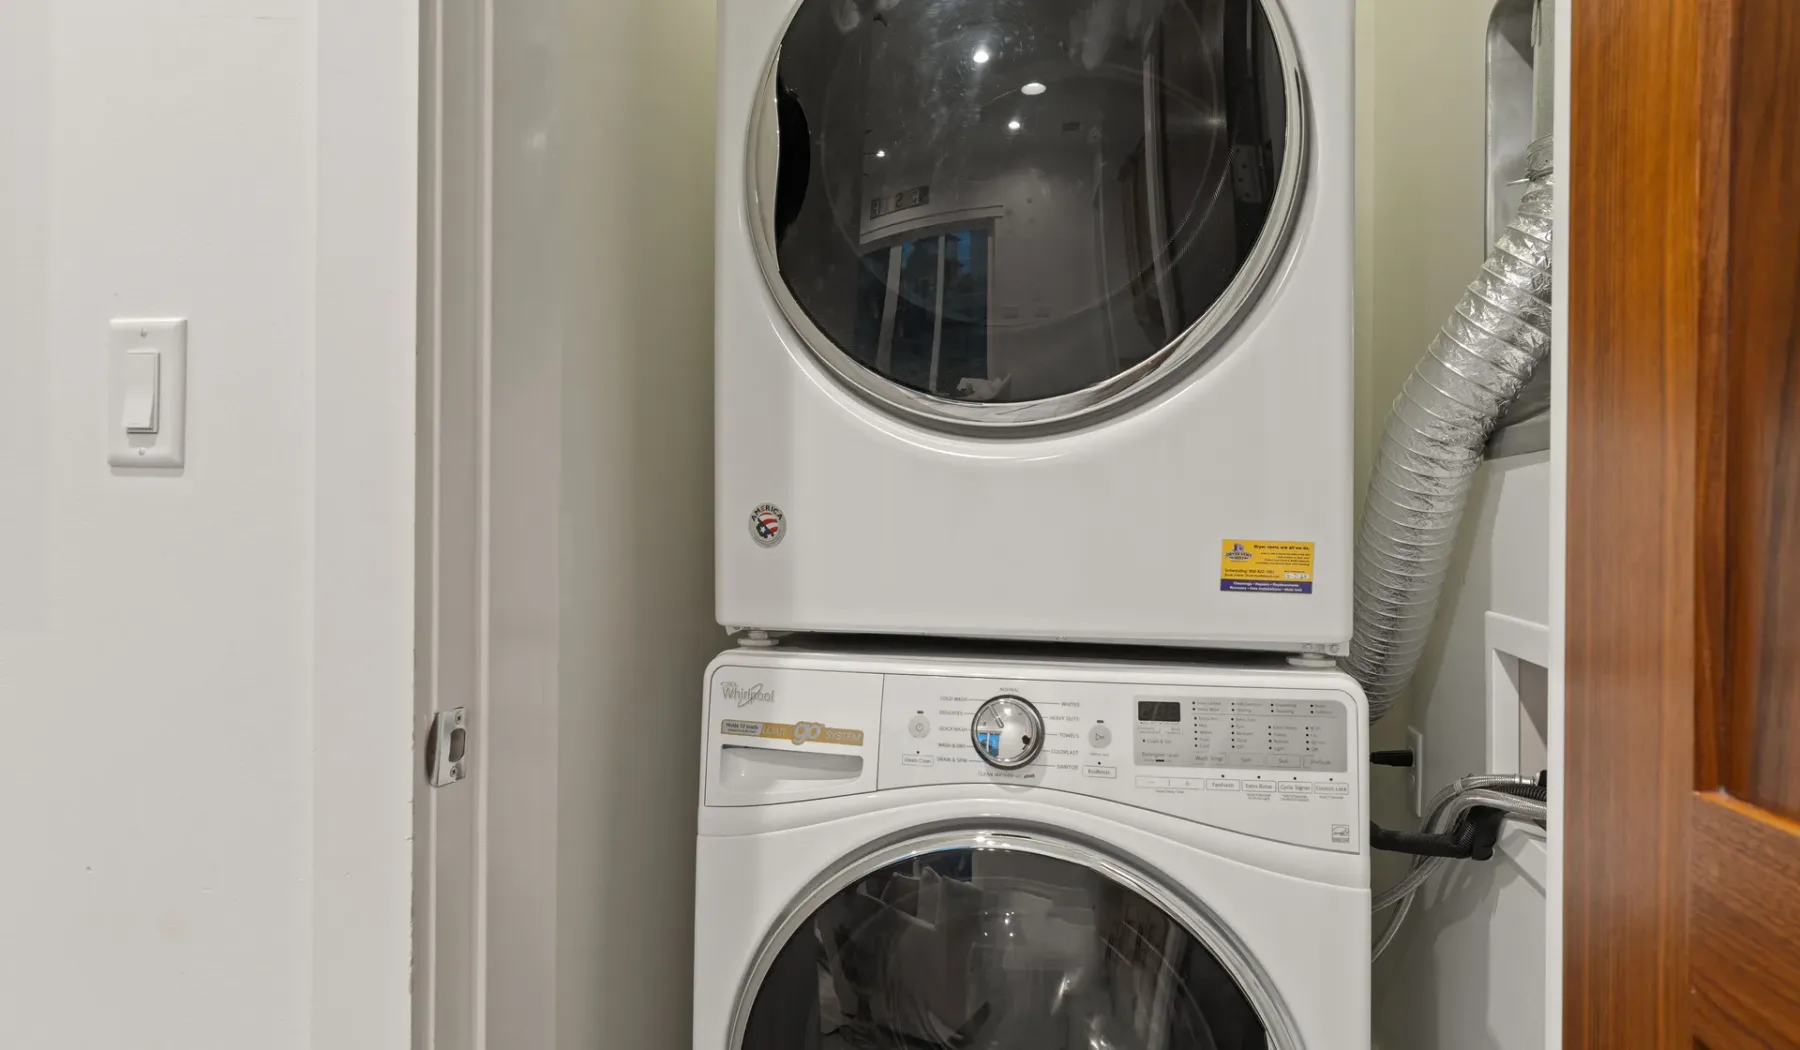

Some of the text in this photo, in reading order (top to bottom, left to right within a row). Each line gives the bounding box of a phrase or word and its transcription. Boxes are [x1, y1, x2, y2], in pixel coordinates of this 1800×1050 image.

[752, 504, 782, 521] AMERICA
[722, 685, 775, 705] Whirlpool
[793, 720, 821, 745] go
[825, 731, 862, 742] SYSTEM
